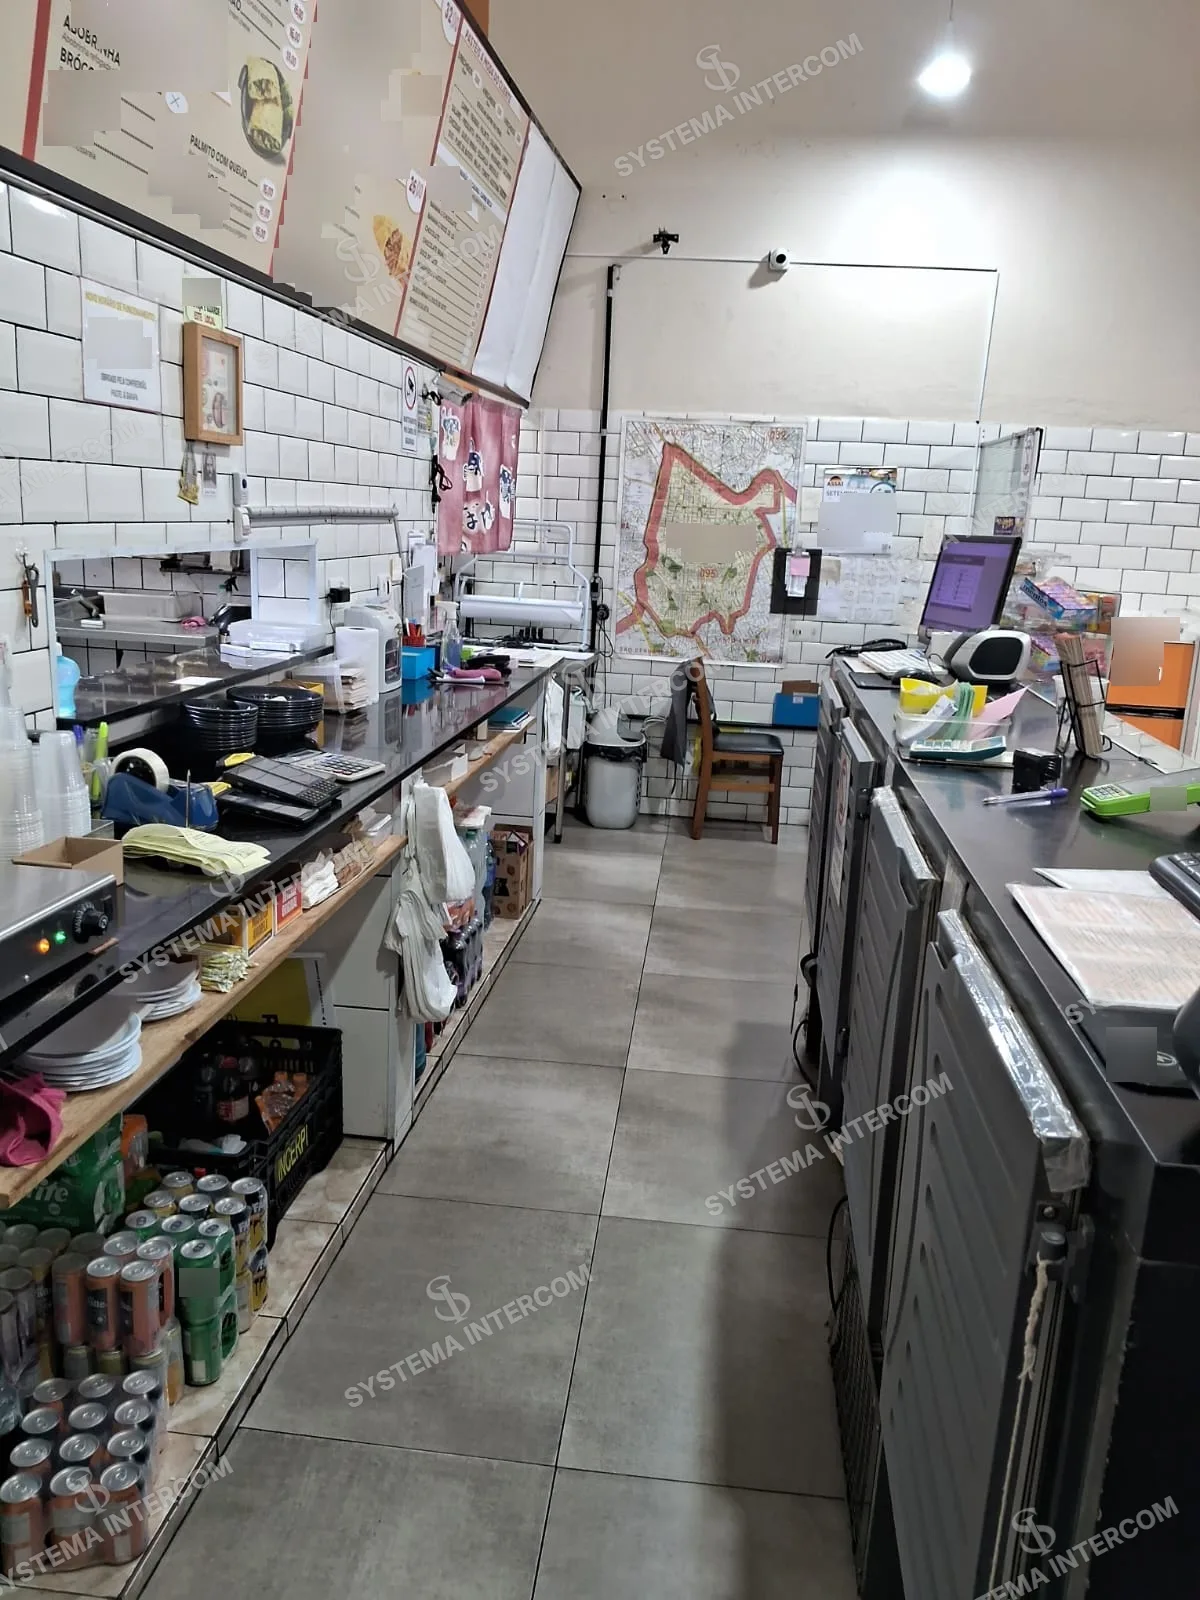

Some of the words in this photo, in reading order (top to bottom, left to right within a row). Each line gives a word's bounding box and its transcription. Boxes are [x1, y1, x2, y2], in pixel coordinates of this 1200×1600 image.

[63, 14, 120, 66] AOBRNHA
[190, 135, 216, 159] PALMITO
[215, 151, 229, 167] COM
[228, 159, 248, 179] QUEIJO
[1022, 584, 1048, 607] mentos
